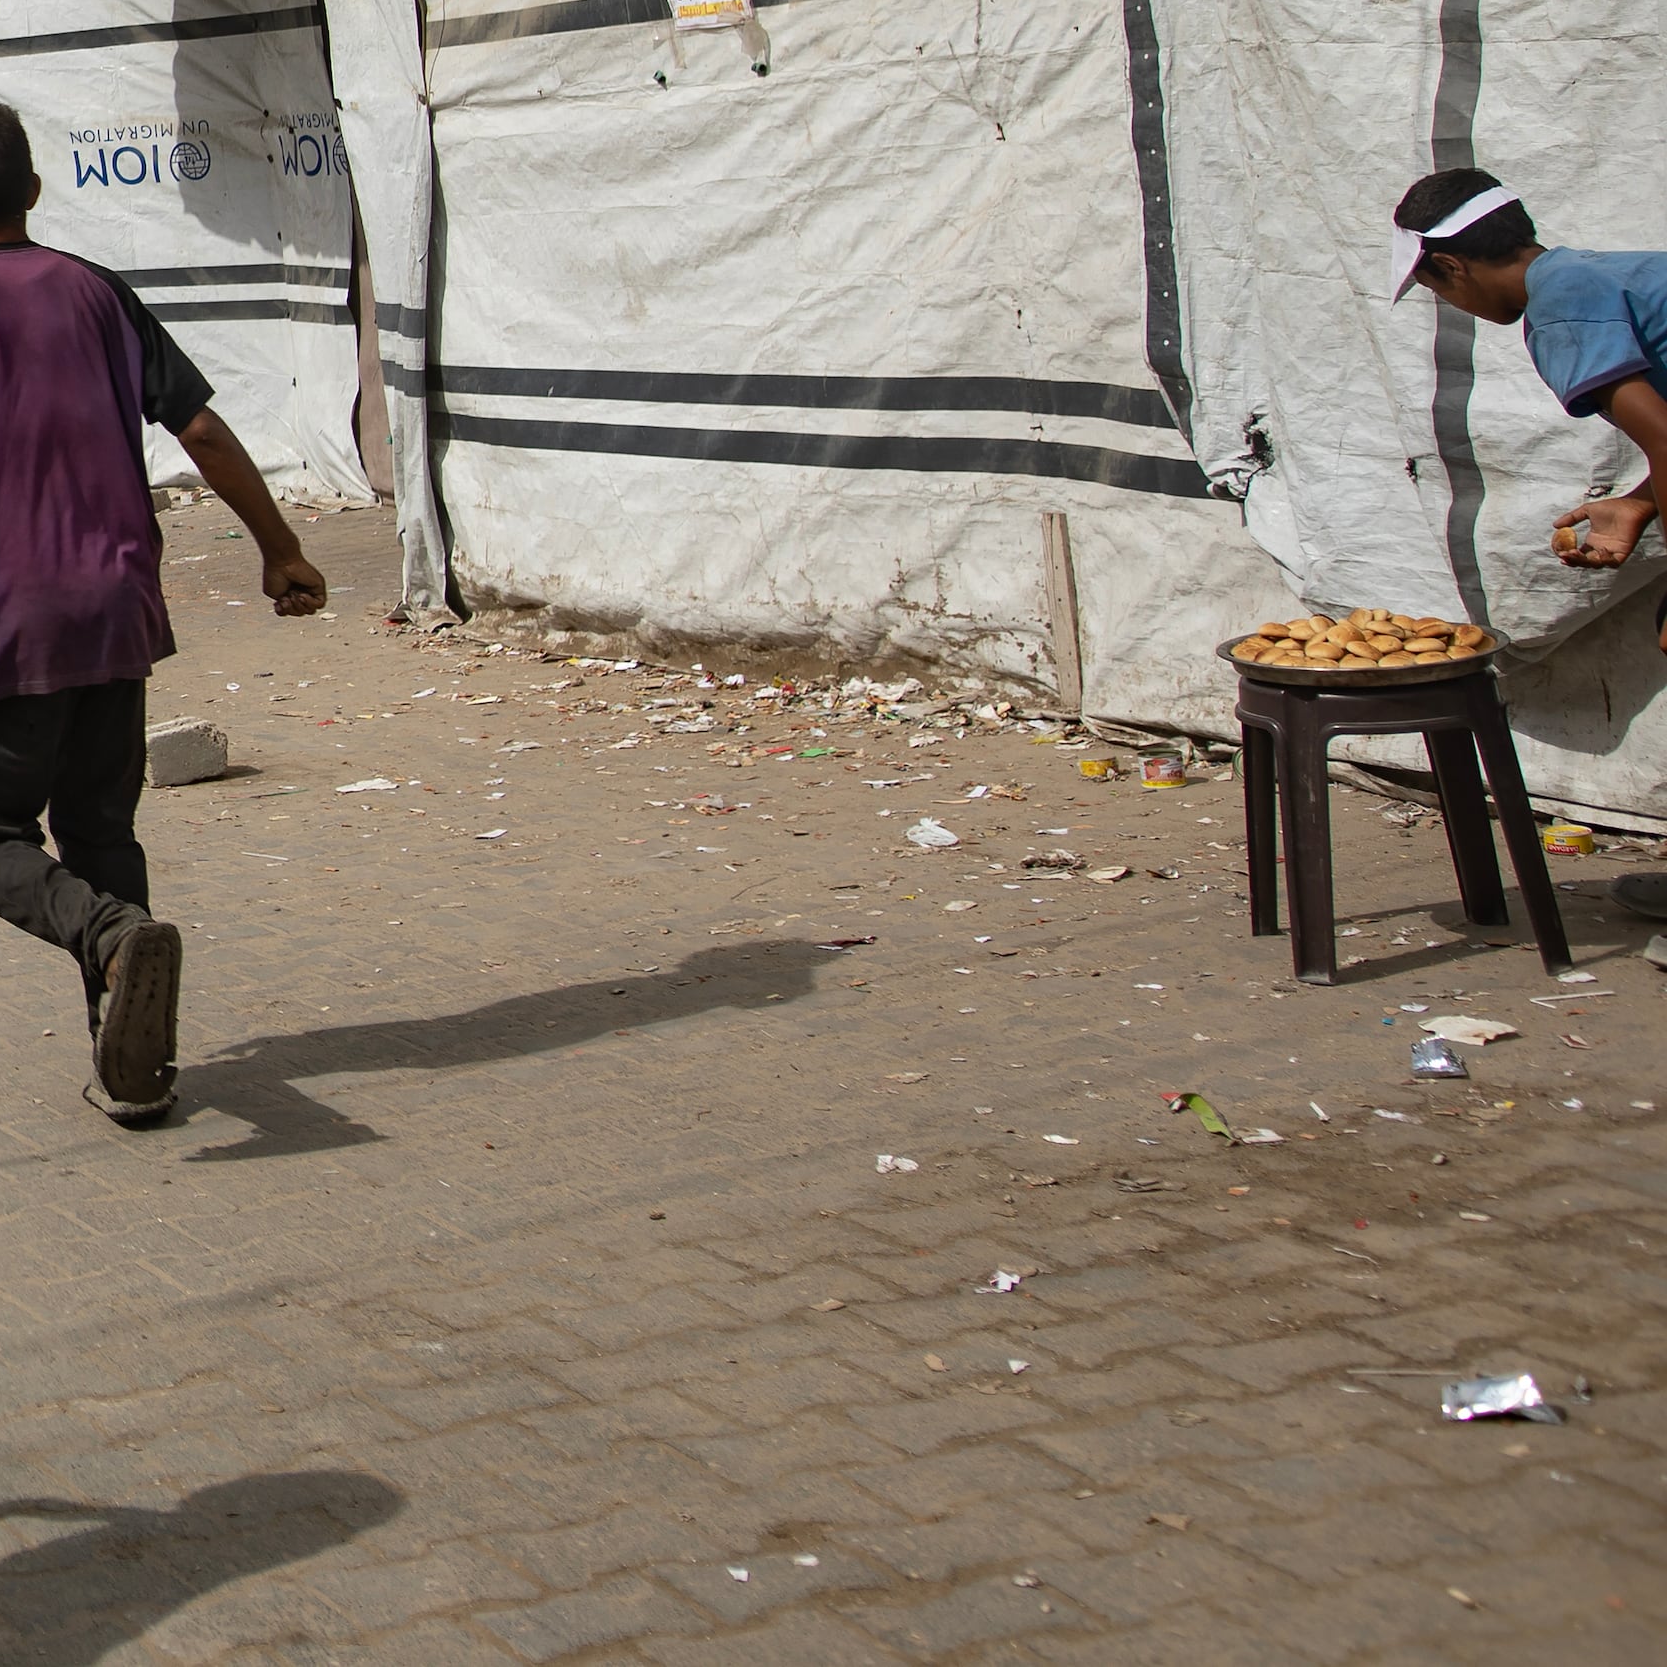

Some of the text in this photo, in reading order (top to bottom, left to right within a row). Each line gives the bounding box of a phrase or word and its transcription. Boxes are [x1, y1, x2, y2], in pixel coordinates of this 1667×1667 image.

[71, 119, 211, 145] UN MIGRATION
[73, 144, 162, 189] IOM
[278, 134, 331, 177] IOM
